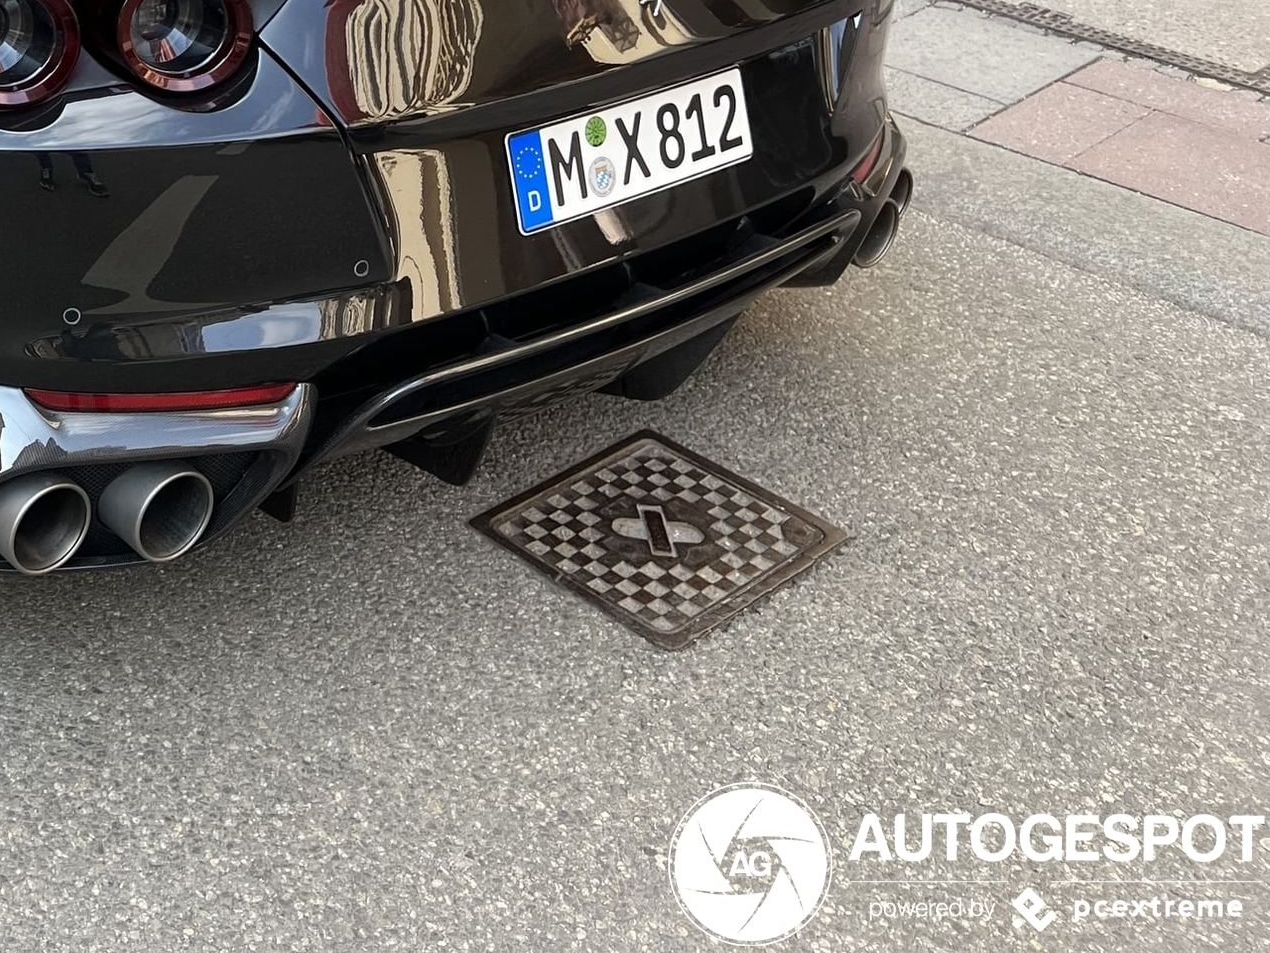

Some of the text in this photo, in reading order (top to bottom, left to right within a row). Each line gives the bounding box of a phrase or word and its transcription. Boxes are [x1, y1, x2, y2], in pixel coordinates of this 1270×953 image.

[547, 130, 588, 207] M
[614, 110, 651, 186] X
[656, 84, 744, 169] 812
[527, 190, 542, 212] D
